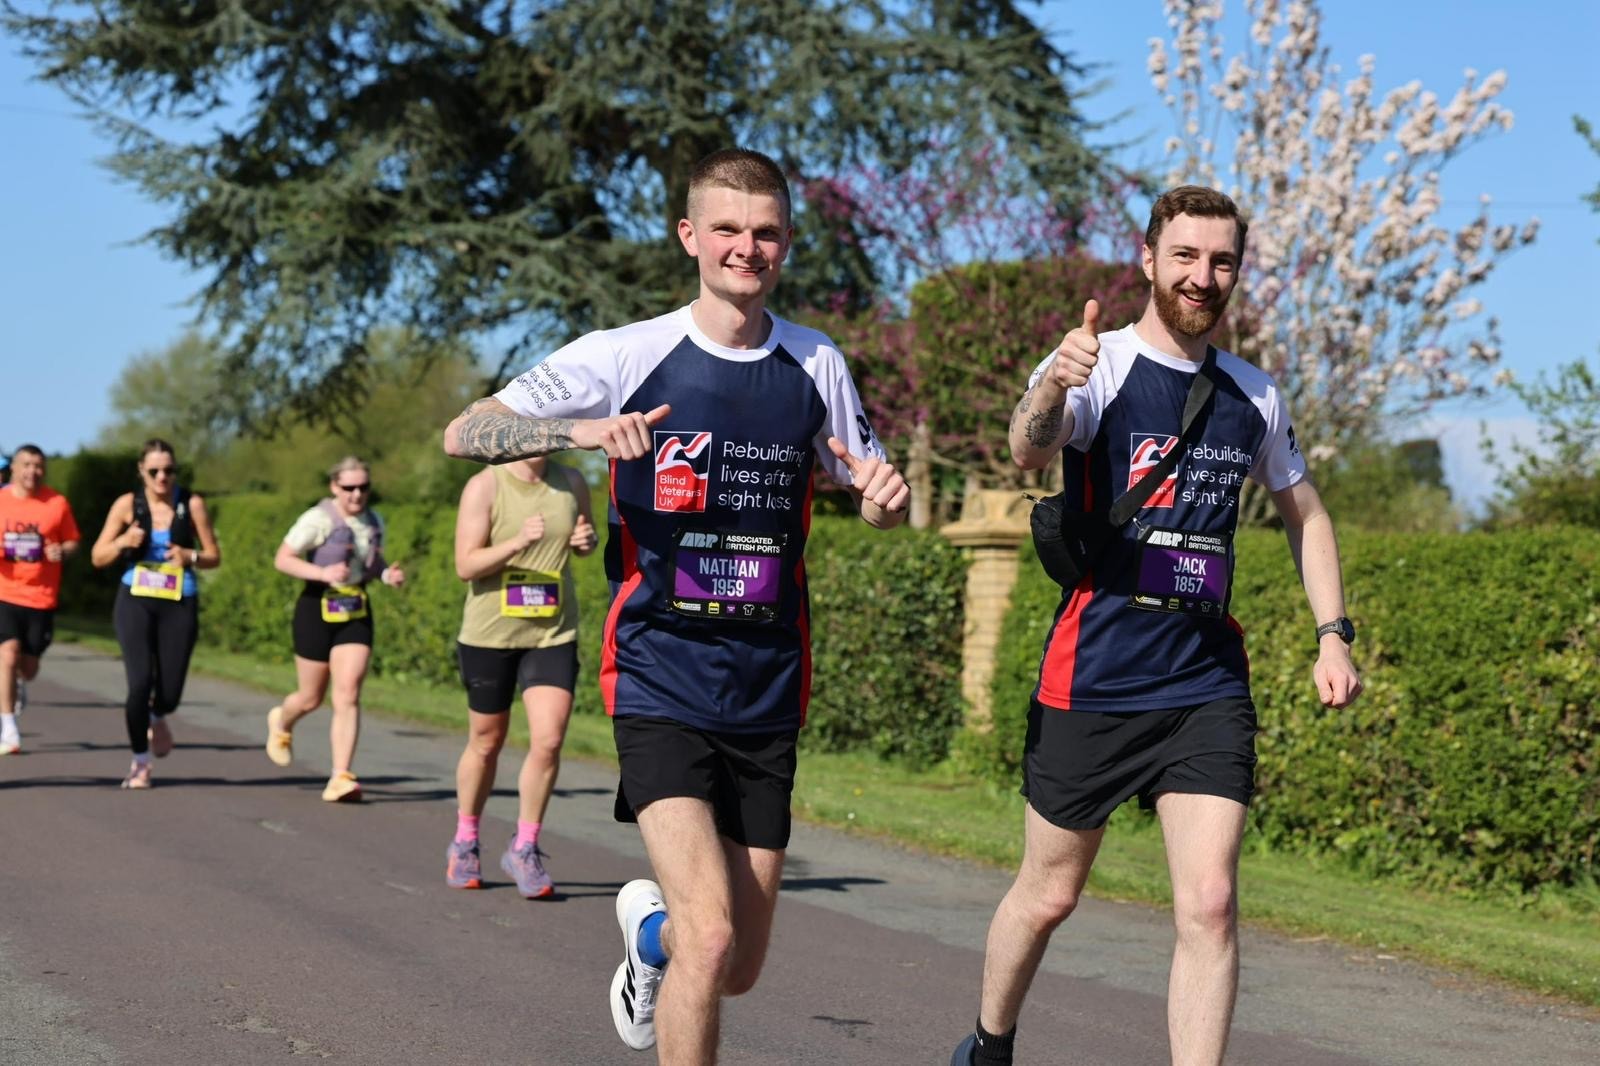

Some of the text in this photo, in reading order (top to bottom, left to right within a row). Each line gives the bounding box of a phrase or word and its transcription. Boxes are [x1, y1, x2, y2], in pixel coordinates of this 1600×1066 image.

[531, 391, 546, 409] loss
[538, 381, 559, 402] after
[660, 474, 686, 486] Blind
[720, 464, 760, 484] lives
[659, 485, 702, 498] Veterans
[1182, 487, 1218, 507] sight
[659, 496, 675, 507] UK
[718, 490, 762, 511] sight
[679, 532, 719, 549] ABP
[726, 535, 773, 545] ASSOCIATED
[1146, 530, 1183, 547] ABP
[1188, 534, 1222, 545] ASSOCIATED
[1188, 541, 1211, 551] BRITISH
[725, 543, 781, 554] BRITISH PORTS
[699, 557, 760, 578] NATHAN
[1173, 556, 1207, 576] JACK
[711, 578, 745, 598] 1959
[1174, 575, 1204, 594] 1857
